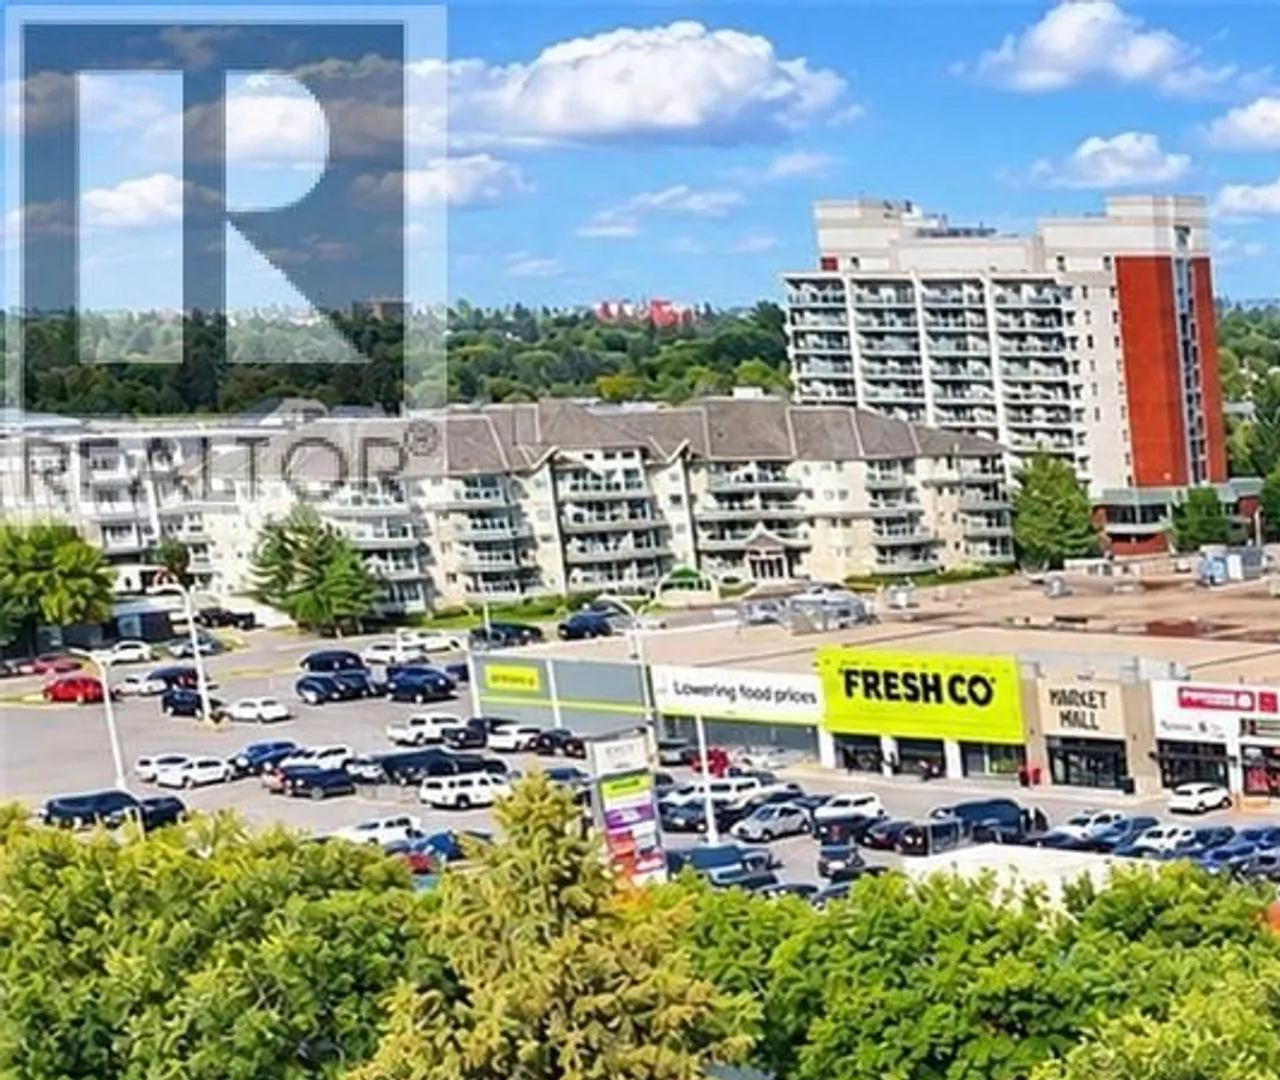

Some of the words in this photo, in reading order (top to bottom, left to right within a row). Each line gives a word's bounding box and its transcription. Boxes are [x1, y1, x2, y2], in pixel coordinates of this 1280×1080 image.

[739, 684, 770, 701] food
[1049, 688, 1107, 709] MARKET
[1059, 709, 1099, 730] MALL
